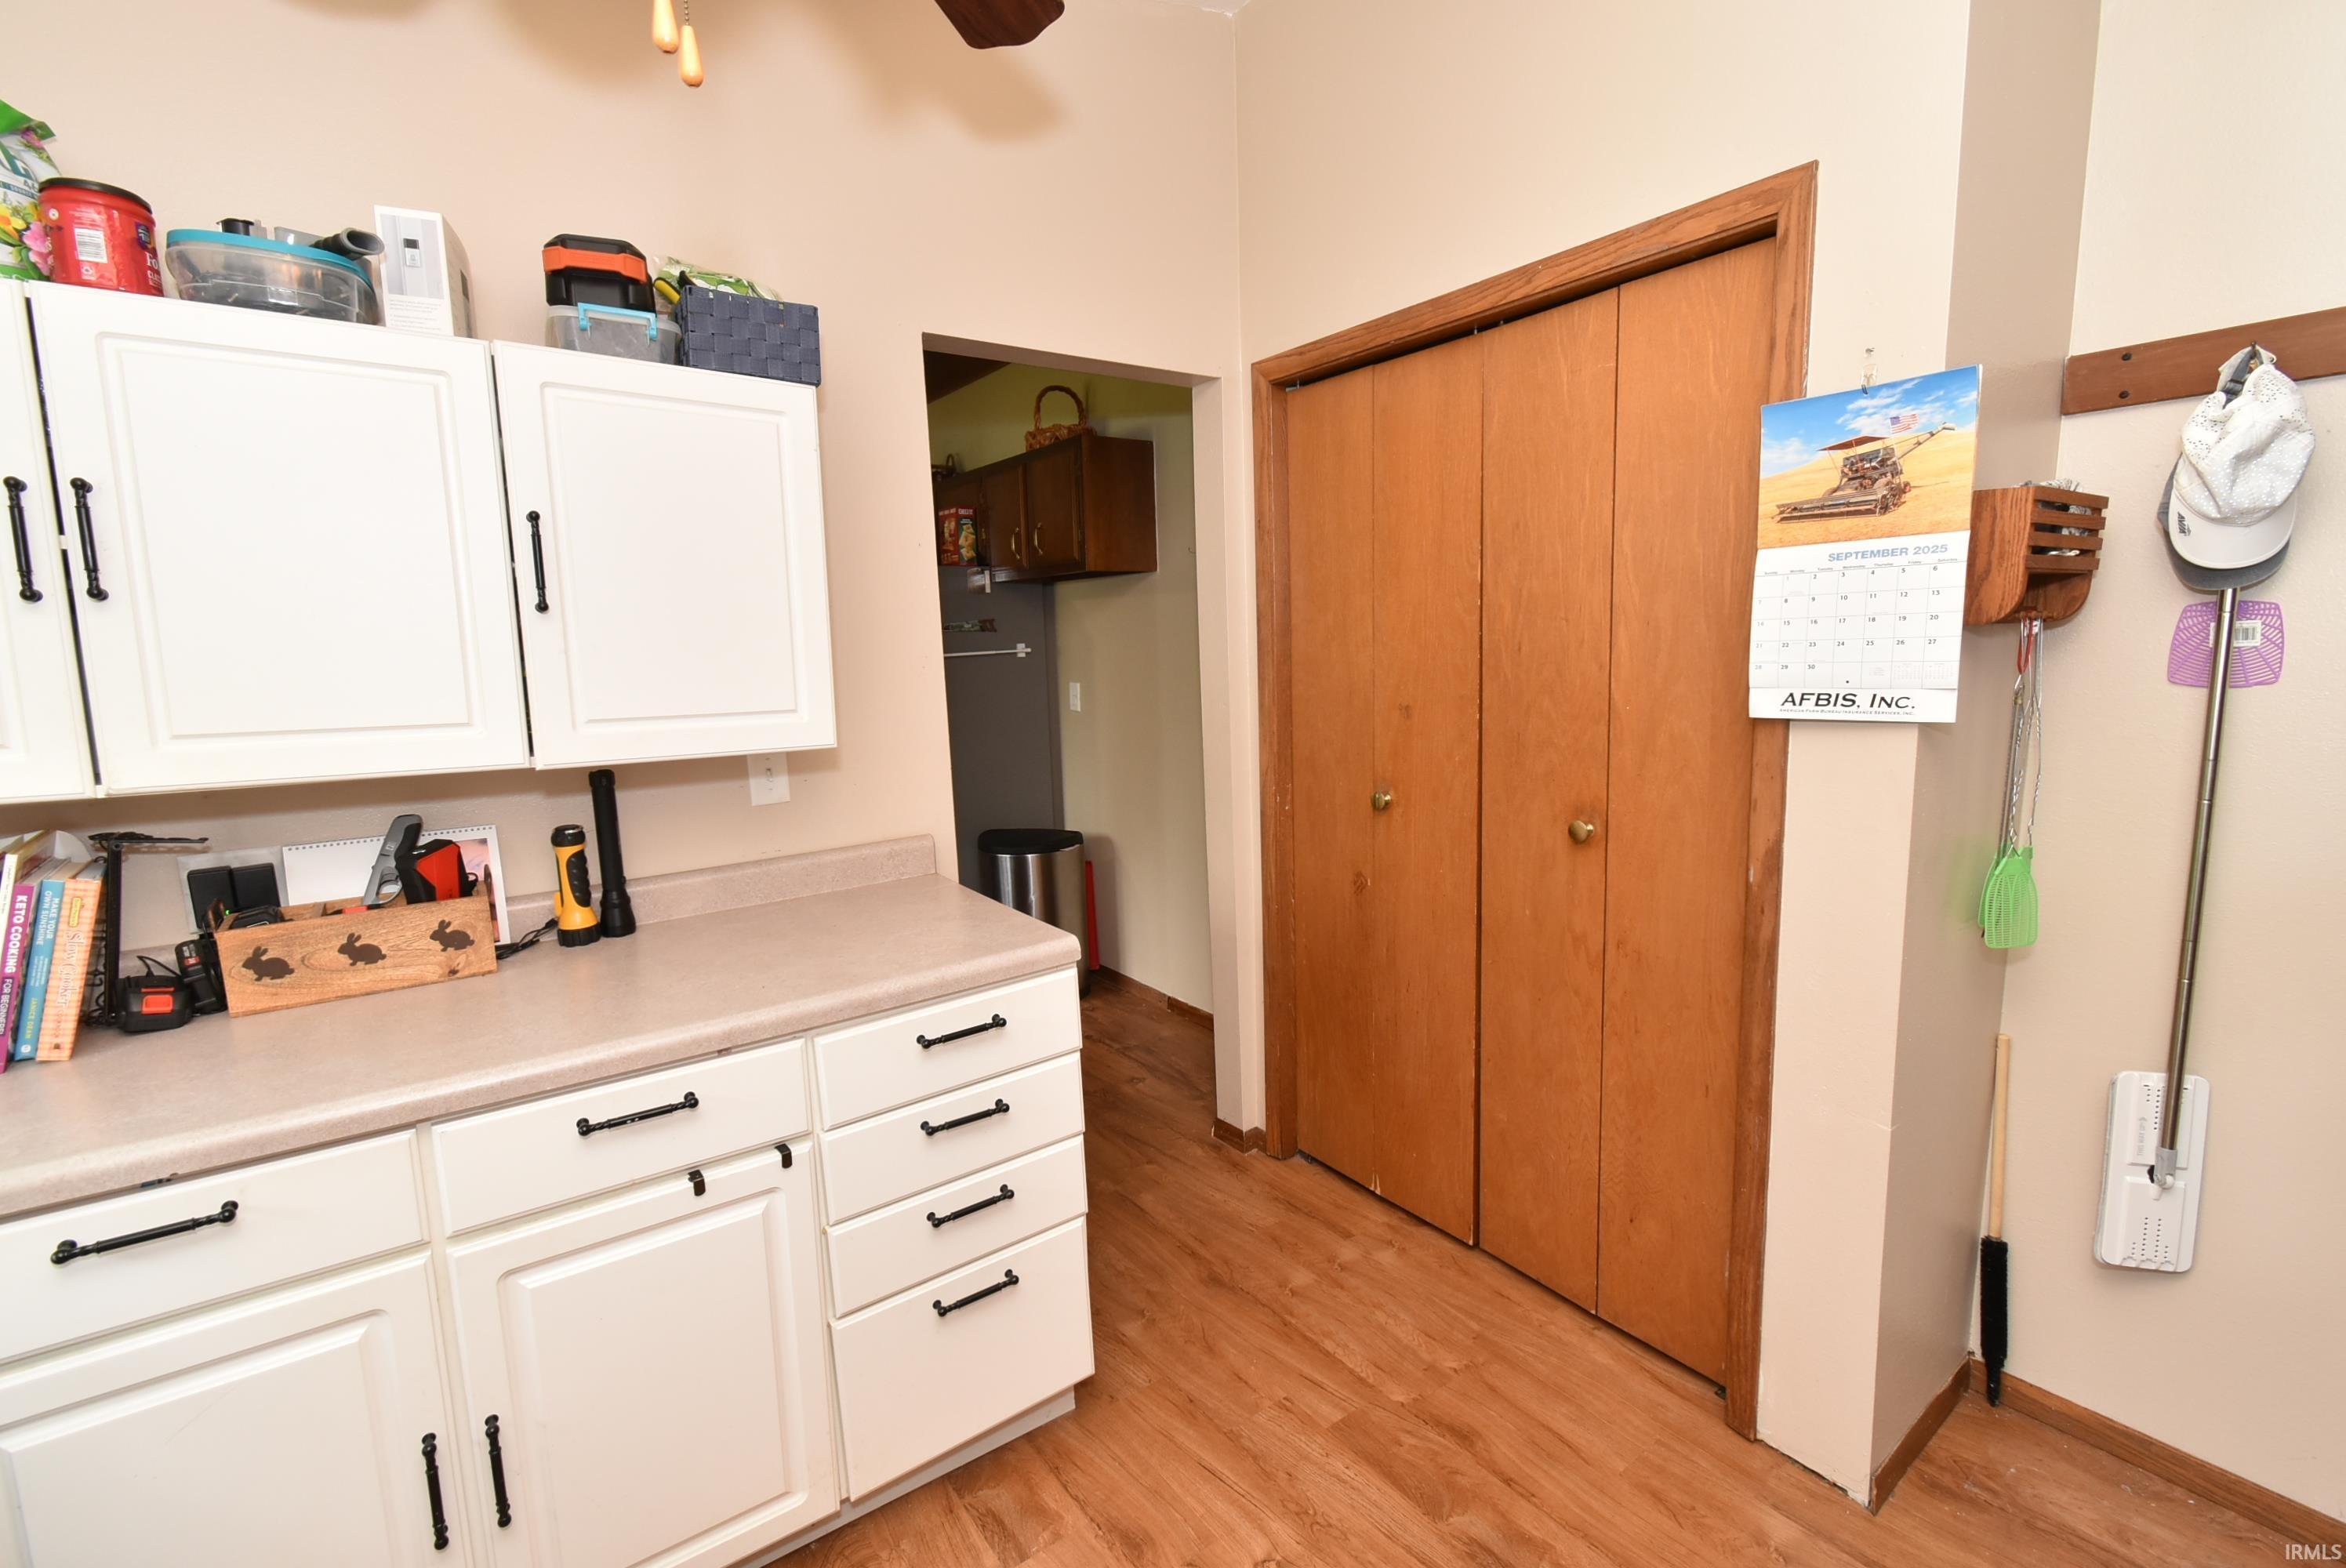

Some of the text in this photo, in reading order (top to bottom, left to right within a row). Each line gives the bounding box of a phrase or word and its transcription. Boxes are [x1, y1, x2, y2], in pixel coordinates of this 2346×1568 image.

[1828, 544, 1948, 562] SEPTEMBER 2025
[1780, 691, 1916, 709] AFBIS, INC.
[13, 895, 28, 924] KETO
[42, 891, 53, 909] OWN
[36, 909, 49, 946] SUNSHINE
[45, 897, 60, 939] MAKE YOUR
[4, 926, 23, 973] COOKING
[66, 931, 85, 960] Slow
[2, 978, 13, 994] FOR
